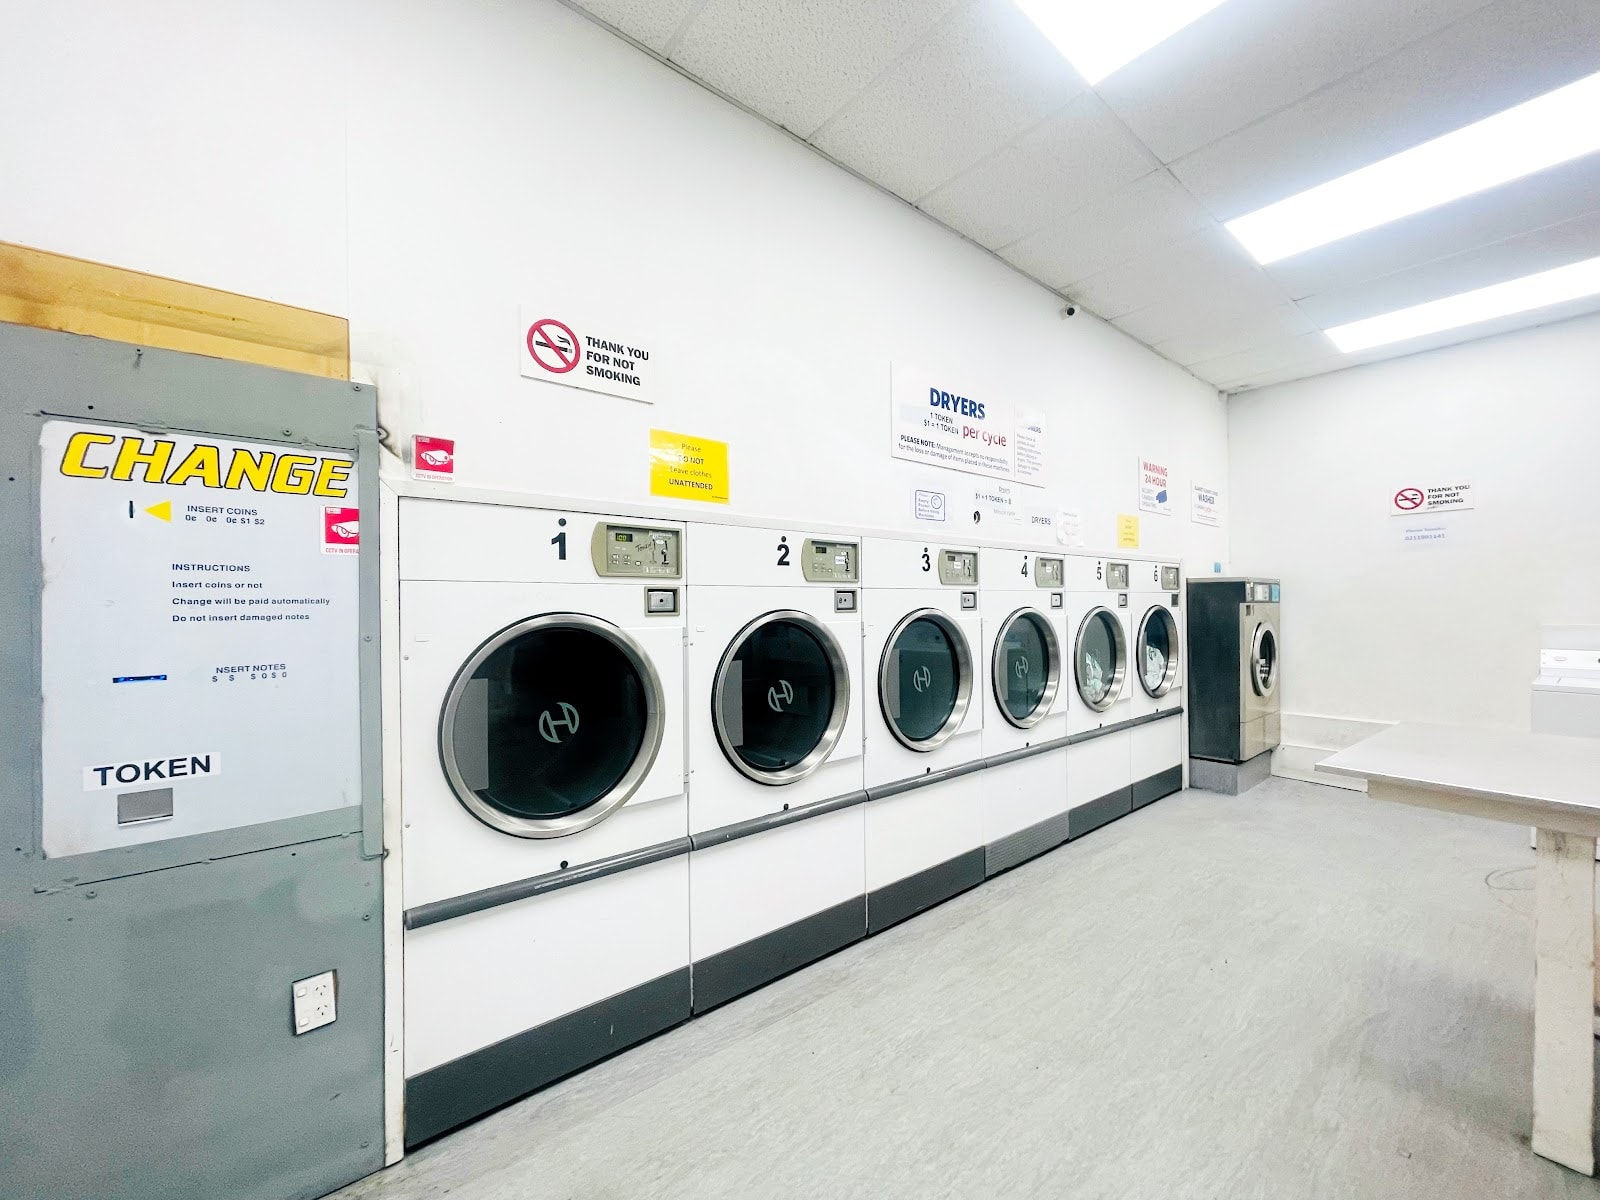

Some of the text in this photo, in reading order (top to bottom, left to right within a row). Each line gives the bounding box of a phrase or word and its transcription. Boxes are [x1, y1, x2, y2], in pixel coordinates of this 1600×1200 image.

[586, 335, 649, 361] THANK YOU
[586, 350, 635, 371] FOR NOT
[586, 365, 641, 387] SMOKING
[929, 387, 986, 421] DRYERS
[934, 413, 953, 424] TOKEN
[900, 434, 920, 445] PLEASE
[940, 424, 959, 435] TOKEN
[962, 425, 980, 439] per
[982, 430, 1007, 447] cycle
[681, 443, 701, 453] Please
[60, 431, 354, 498] CHANGE
[690, 456, 704, 465] NOT
[689, 469, 712, 479] clothes
[1143, 461, 1168, 477] WARNING
[668, 478, 713, 490] UNATTENDED
[1427, 497, 1464, 506] SMOKING
[187, 505, 258, 516] INSERT COINS
[1031, 515, 1051, 526] DRYERS
[551, 531, 567, 561] 1
[776, 543, 790, 566] 2
[172, 563, 251, 572] INSTRUCTIONS
[921, 553, 931, 572] 3
[1021, 561, 1028, 578] 4
[1096, 566, 1102, 580] 5
[1153, 569, 1158, 582] 6
[172, 580, 202, 589] Insert
[205, 581, 232, 589] coins
[247, 581, 263, 589] not
[172, 597, 330, 607] Change will be paid automatically
[189, 614, 206, 622] not
[209, 614, 237, 622] insert
[240, 613, 283, 623] damaged
[252, 663, 286, 672] NOTES
[93, 754, 211, 786] TOKEN
